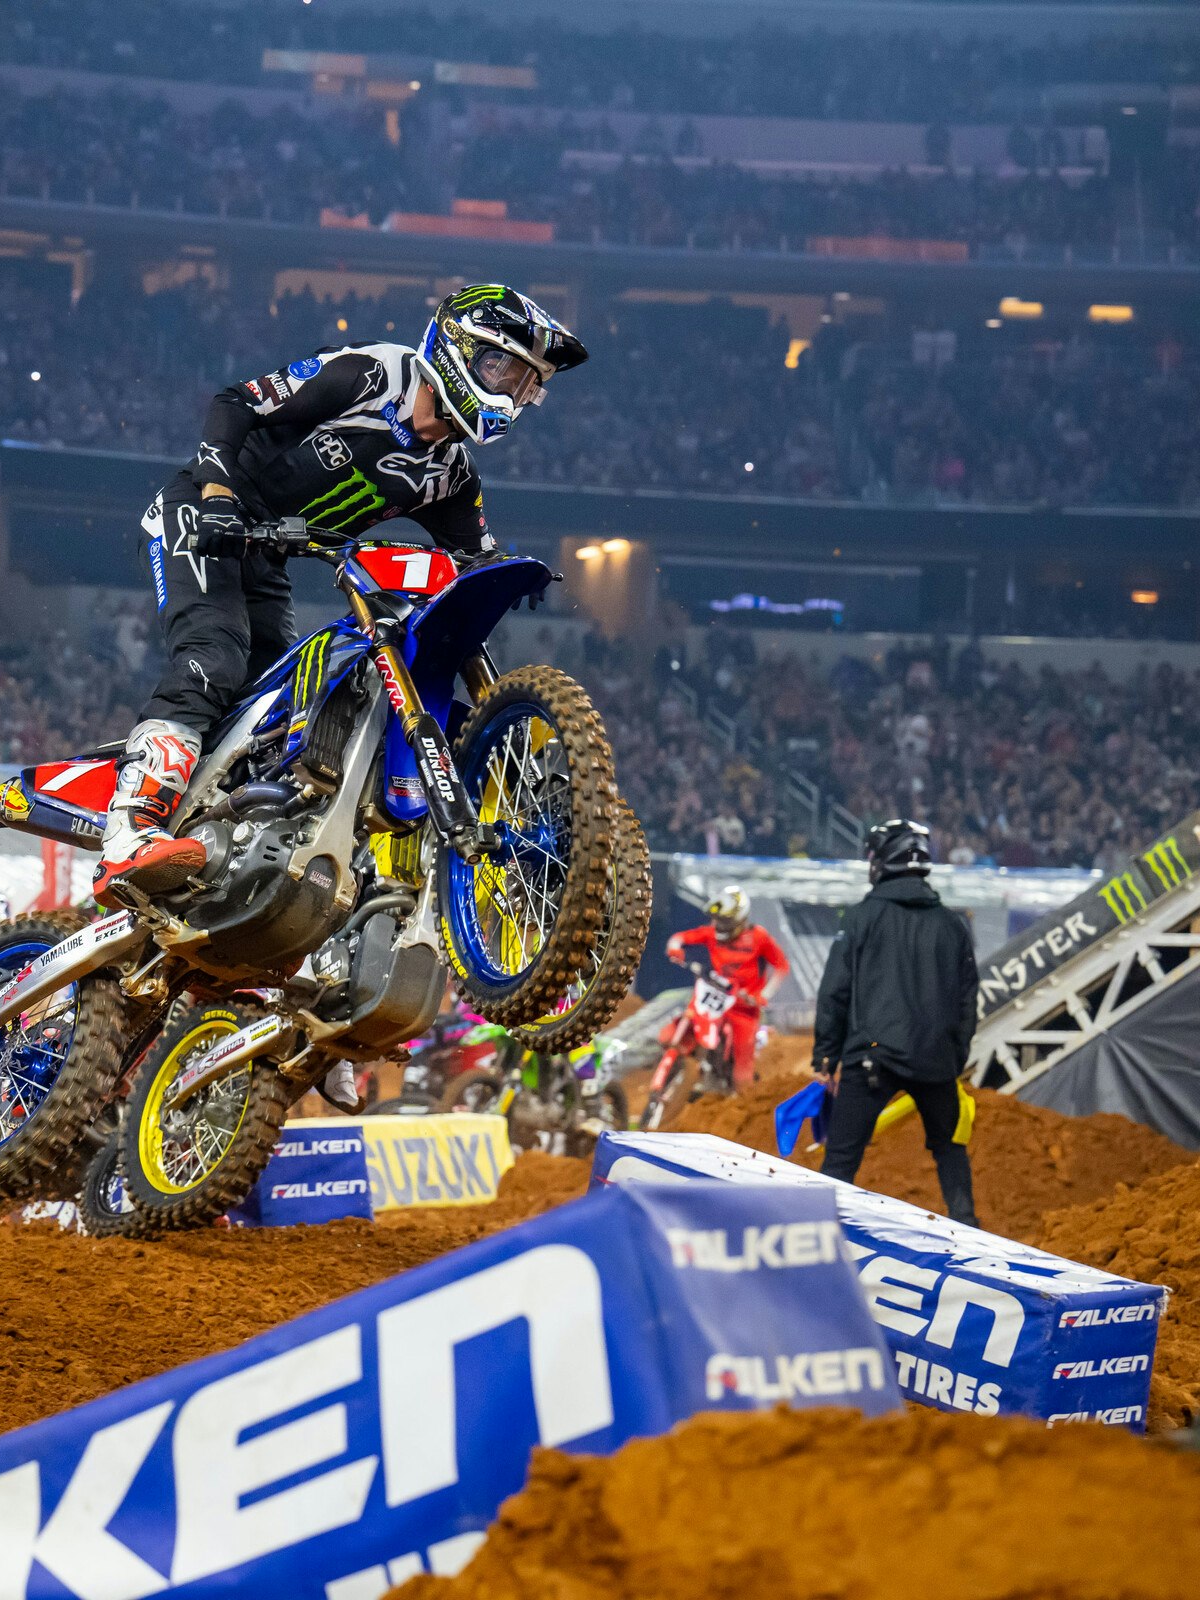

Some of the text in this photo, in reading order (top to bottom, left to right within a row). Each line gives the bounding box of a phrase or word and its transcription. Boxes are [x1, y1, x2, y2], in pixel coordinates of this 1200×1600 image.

[265, 370, 291, 401] ALUBE
[435, 346, 470, 397] MONSTER
[435, 361, 458, 394] ENERGY
[318, 434, 347, 468] PPG
[151, 552, 167, 608] YAMAHA
[391, 552, 432, 588] 1
[421, 736, 456, 803] DUNLOP
[94, 923, 131, 943] EXCE
[441, 917, 468, 980] DUNLOP
[40, 935, 84, 967] YAMALUBE
[977, 910, 1097, 1020] NSTER
[201, 1009, 238, 1021] DUNLOP
[364, 1133, 500, 1207] SUZUKI
[271, 1179, 367, 1200] FALKEN
[1058, 1304, 1155, 1328] FALKEN
[705, 1346, 886, 1401] FALKEN
[895, 1350, 1002, 1418] TIRES
[1052, 1354, 1149, 1380] FALKEN
